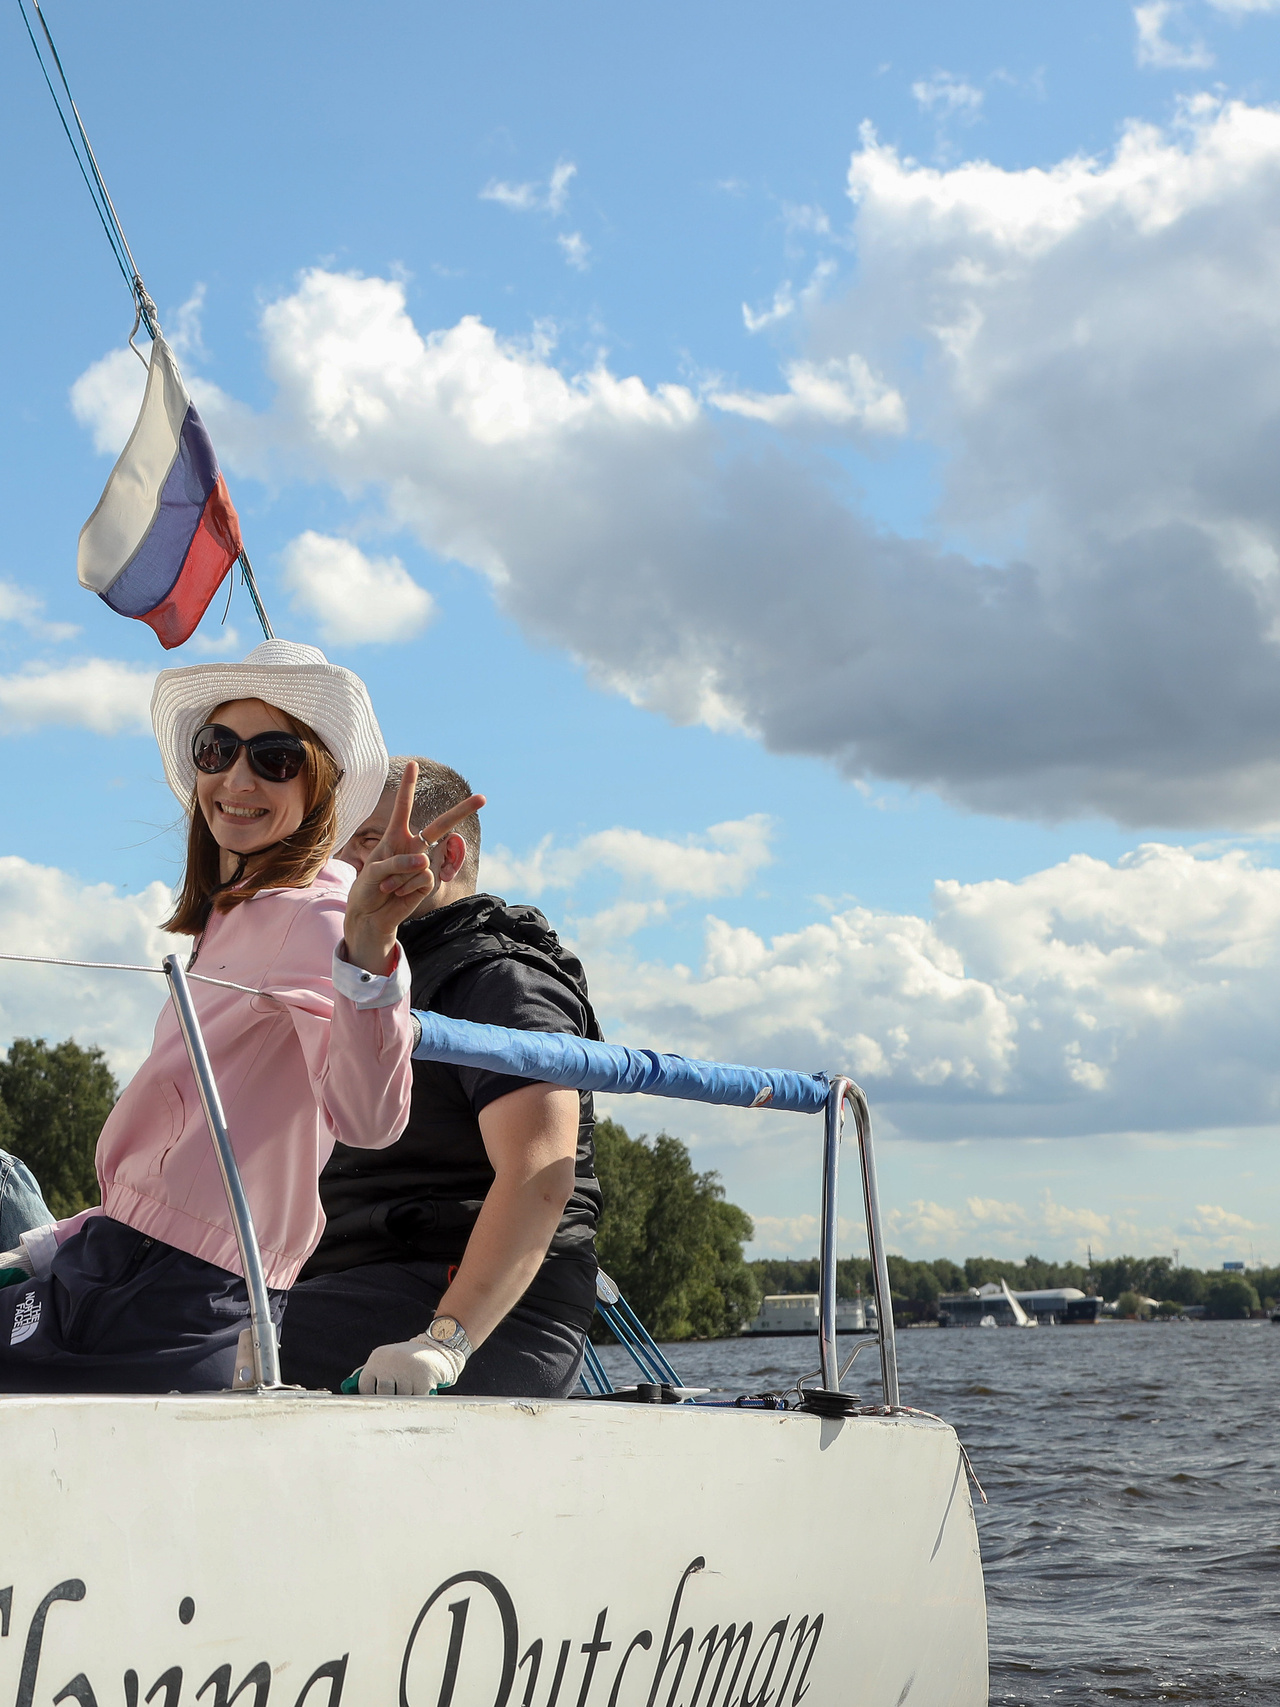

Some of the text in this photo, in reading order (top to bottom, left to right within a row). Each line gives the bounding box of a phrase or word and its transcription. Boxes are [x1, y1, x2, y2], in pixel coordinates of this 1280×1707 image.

[13, 1302, 26, 1328] FACE
[22, 1291, 36, 1326] NORTH
[31, 1301, 42, 1322] THE
[399, 1555, 825, 1707] Dutchman
